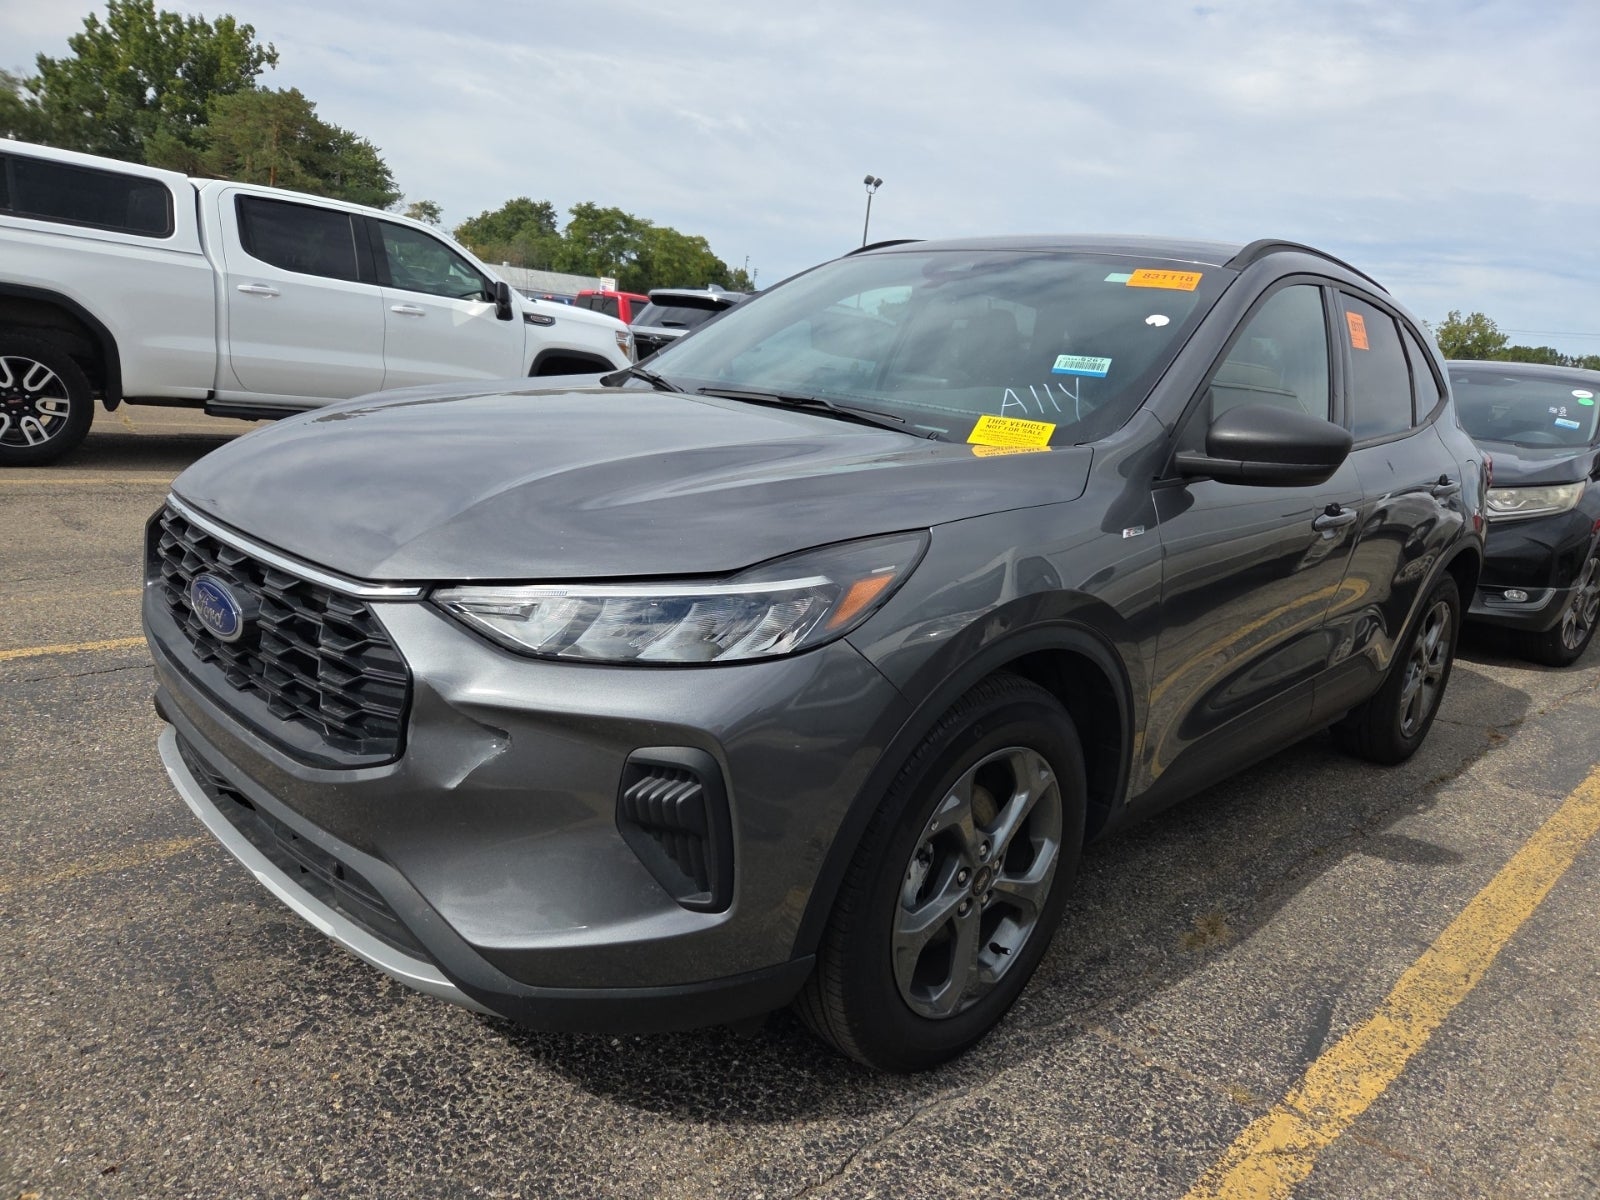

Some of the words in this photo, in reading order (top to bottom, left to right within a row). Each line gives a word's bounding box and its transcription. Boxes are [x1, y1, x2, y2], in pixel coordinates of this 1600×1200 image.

[1142, 273, 1194, 282] 831118
[987, 418, 1007, 426] THIS
[1010, 421, 1048, 431] VEHICLE
